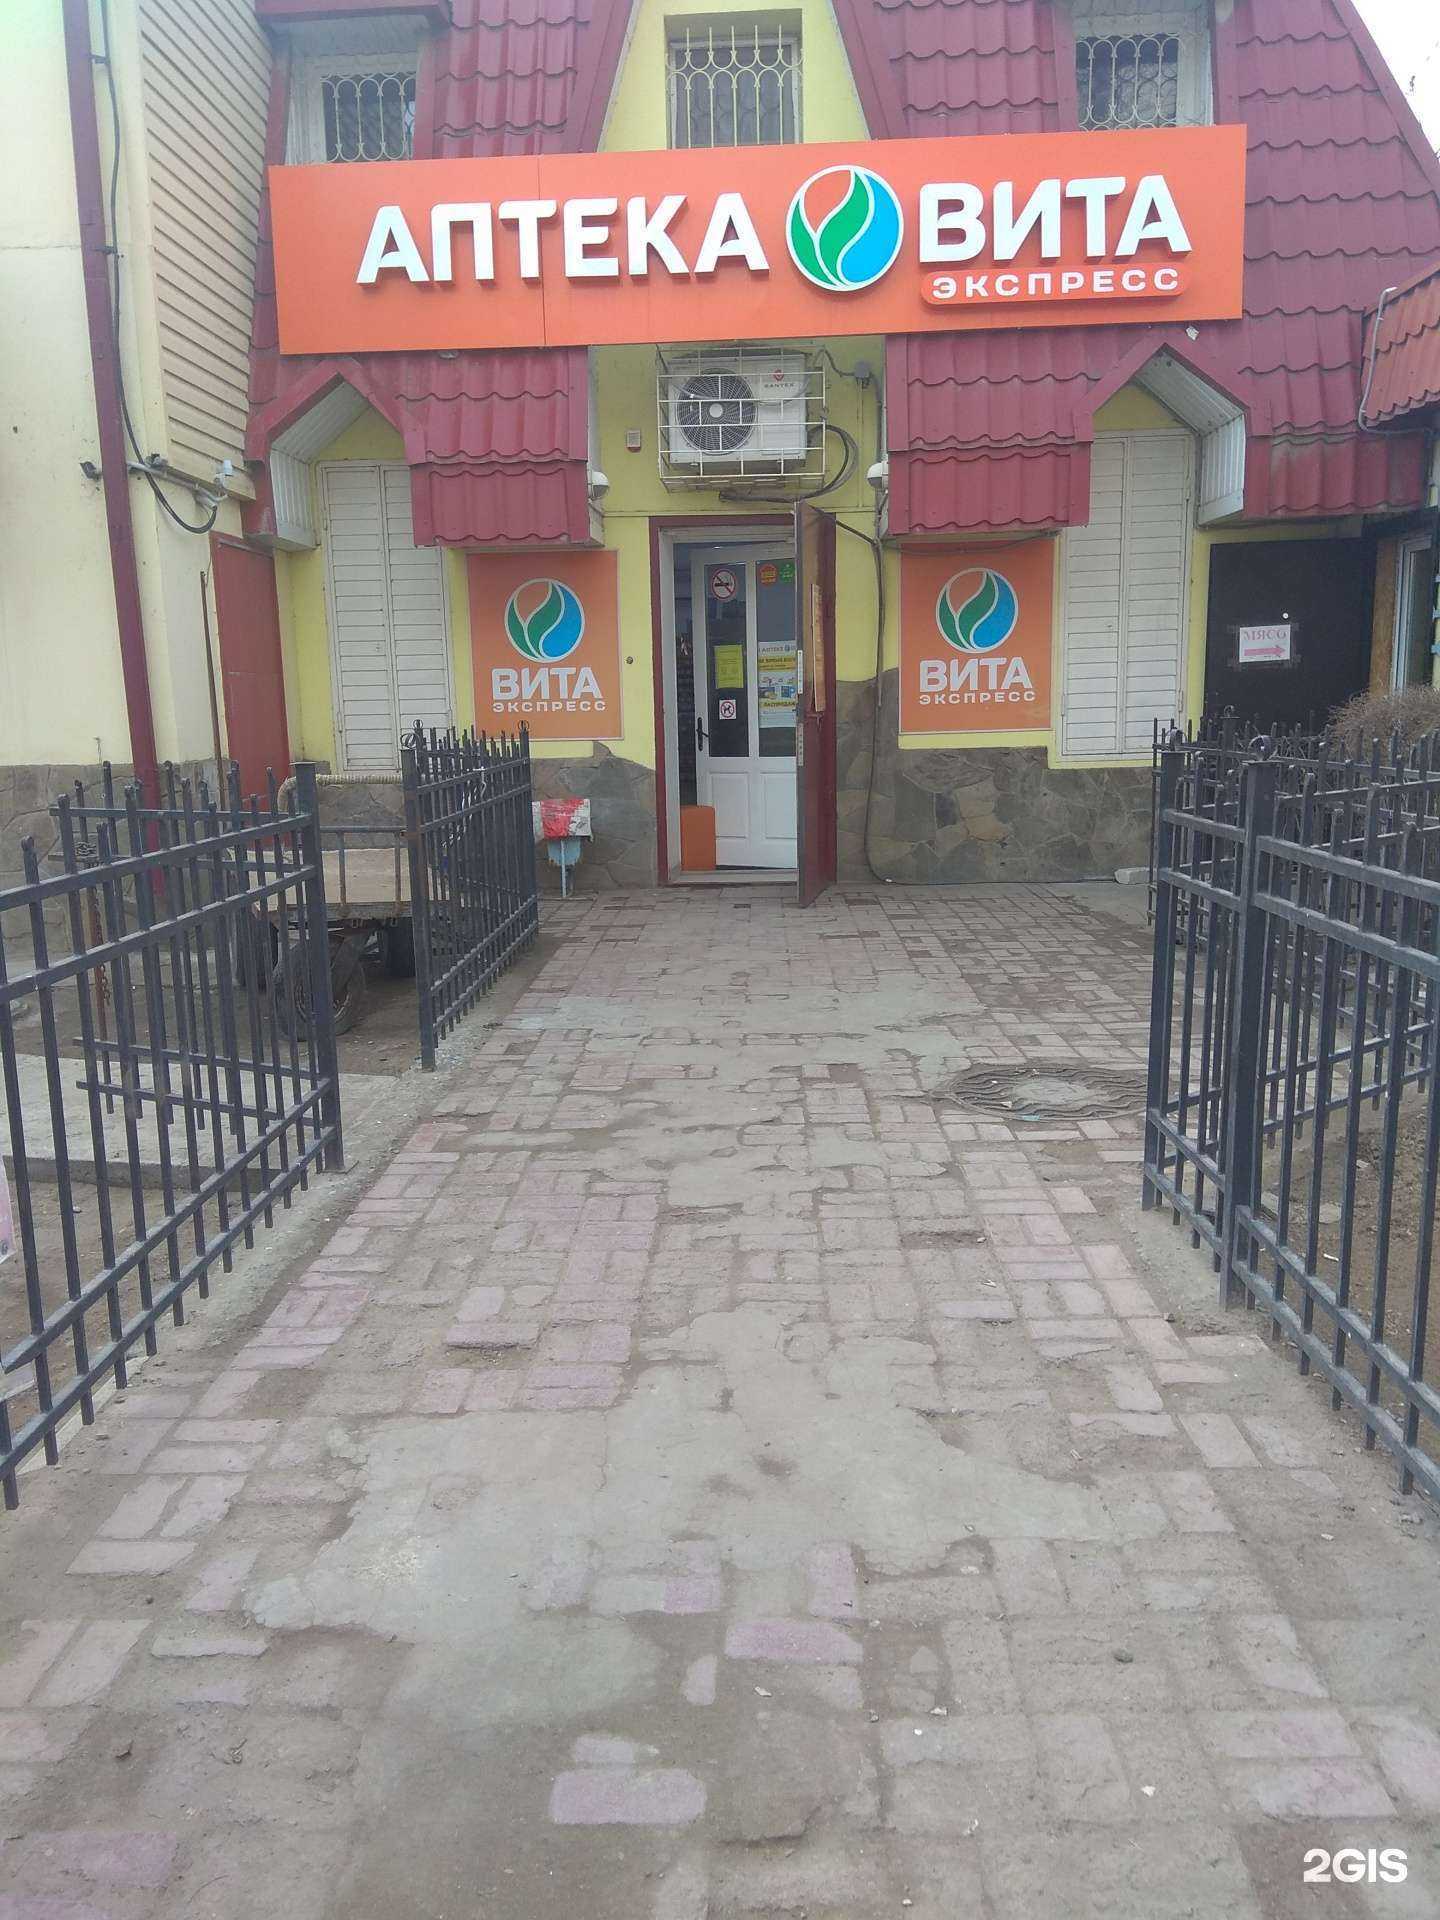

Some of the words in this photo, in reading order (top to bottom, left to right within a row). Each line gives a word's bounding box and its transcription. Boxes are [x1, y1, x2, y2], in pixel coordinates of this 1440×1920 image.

[356, 193, 769, 285] АПТЕКА
[919, 174, 1192, 263] ВИТА
[932, 268, 1178, 299] ЭКСПРЕСС
[491, 666, 603, 700] ВИТА
[919, 656, 1033, 692] ВИТА
[493, 701, 606, 712] ЭКСПРЕСС
[919, 691, 1036, 705] ЭКСПРЕСС
